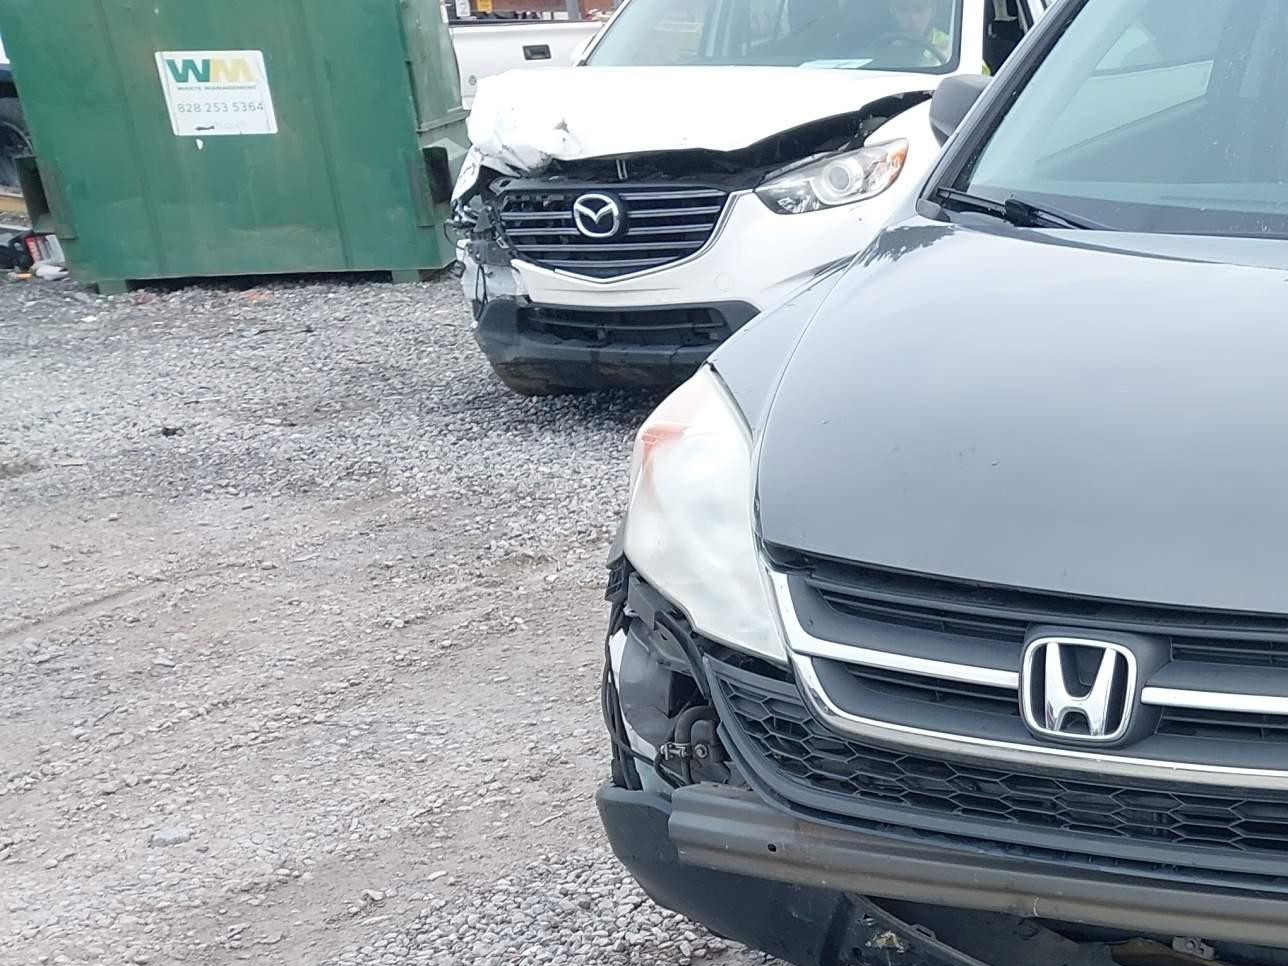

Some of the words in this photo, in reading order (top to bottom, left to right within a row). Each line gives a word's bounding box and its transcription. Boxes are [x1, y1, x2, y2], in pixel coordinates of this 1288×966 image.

[165, 59, 256, 83] WM
[176, 102, 202, 113] 828
[204, 102, 229, 113] 253
[232, 101, 264, 113] 5364
